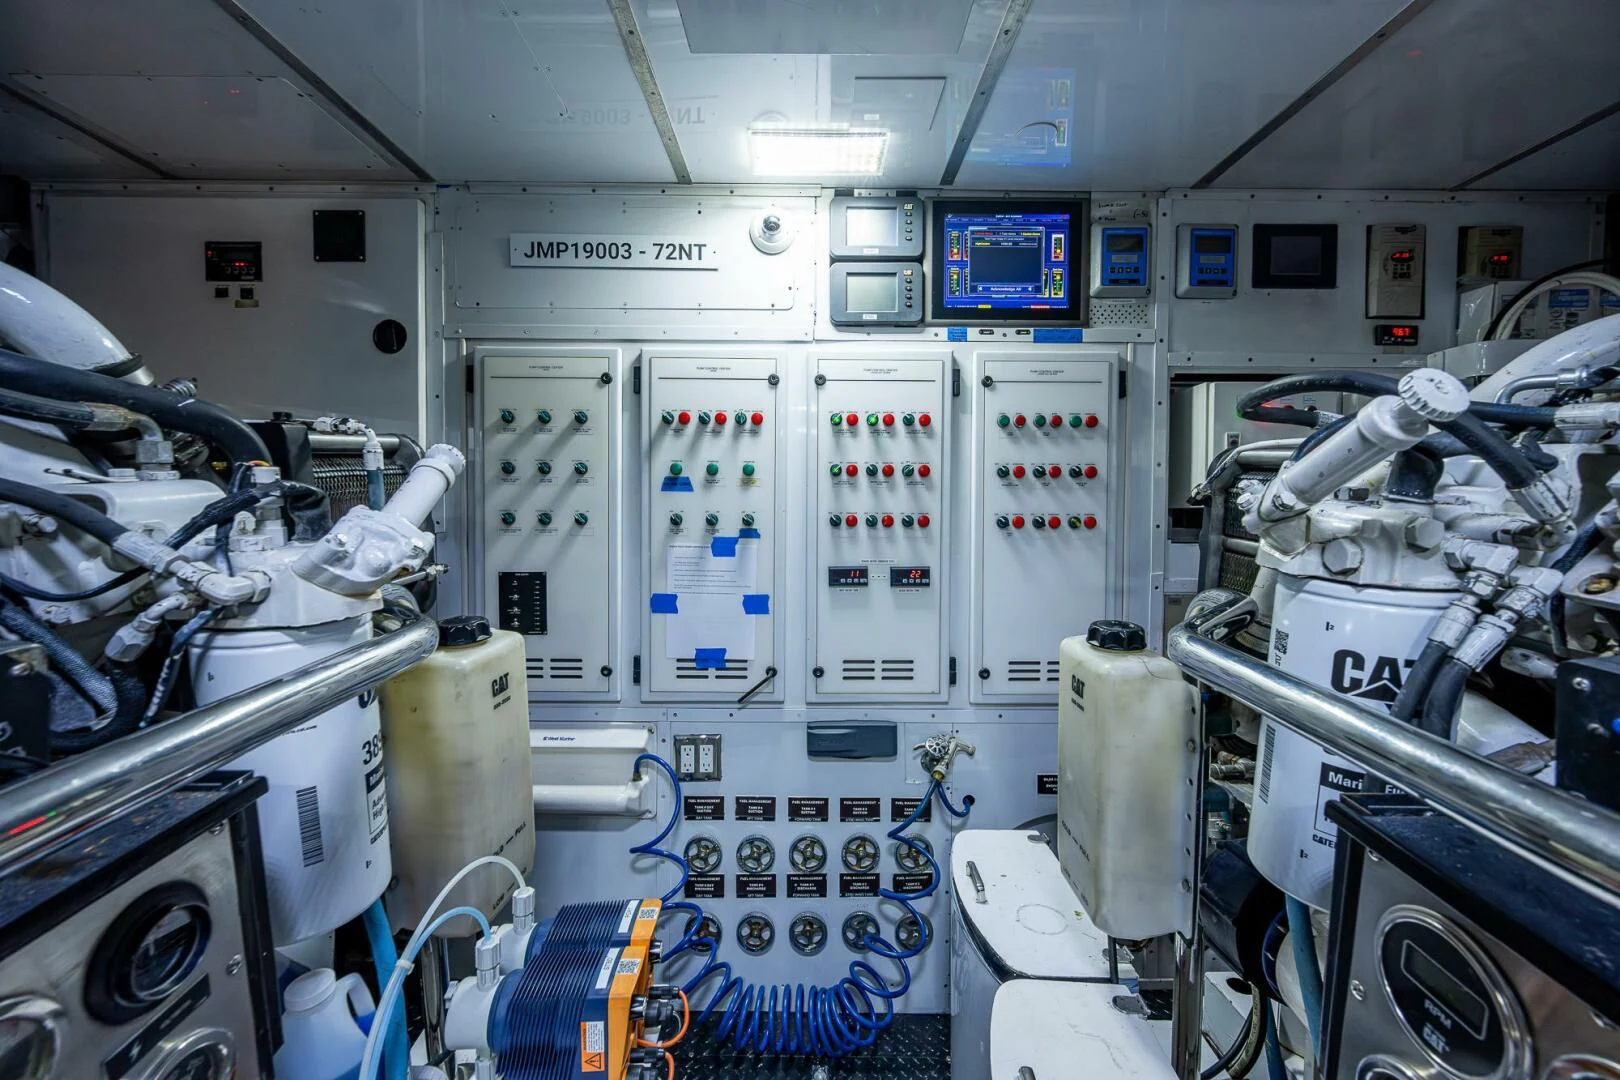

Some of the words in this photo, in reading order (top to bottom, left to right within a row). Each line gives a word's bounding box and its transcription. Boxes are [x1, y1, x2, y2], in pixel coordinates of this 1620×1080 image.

[523, 240, 632, 260] JMP19003
[652, 242, 707, 261] 72NT
[910, 570, 922, 578] 22
[492, 672, 509, 698] CAT
[1072, 674, 1085, 700] CAT
[1331, 649, 1417, 702] CA
[1328, 771, 1363, 790] Mari
[1424, 998, 1452, 1030] RPM
[1423, 1022, 1450, 1053] CAT
